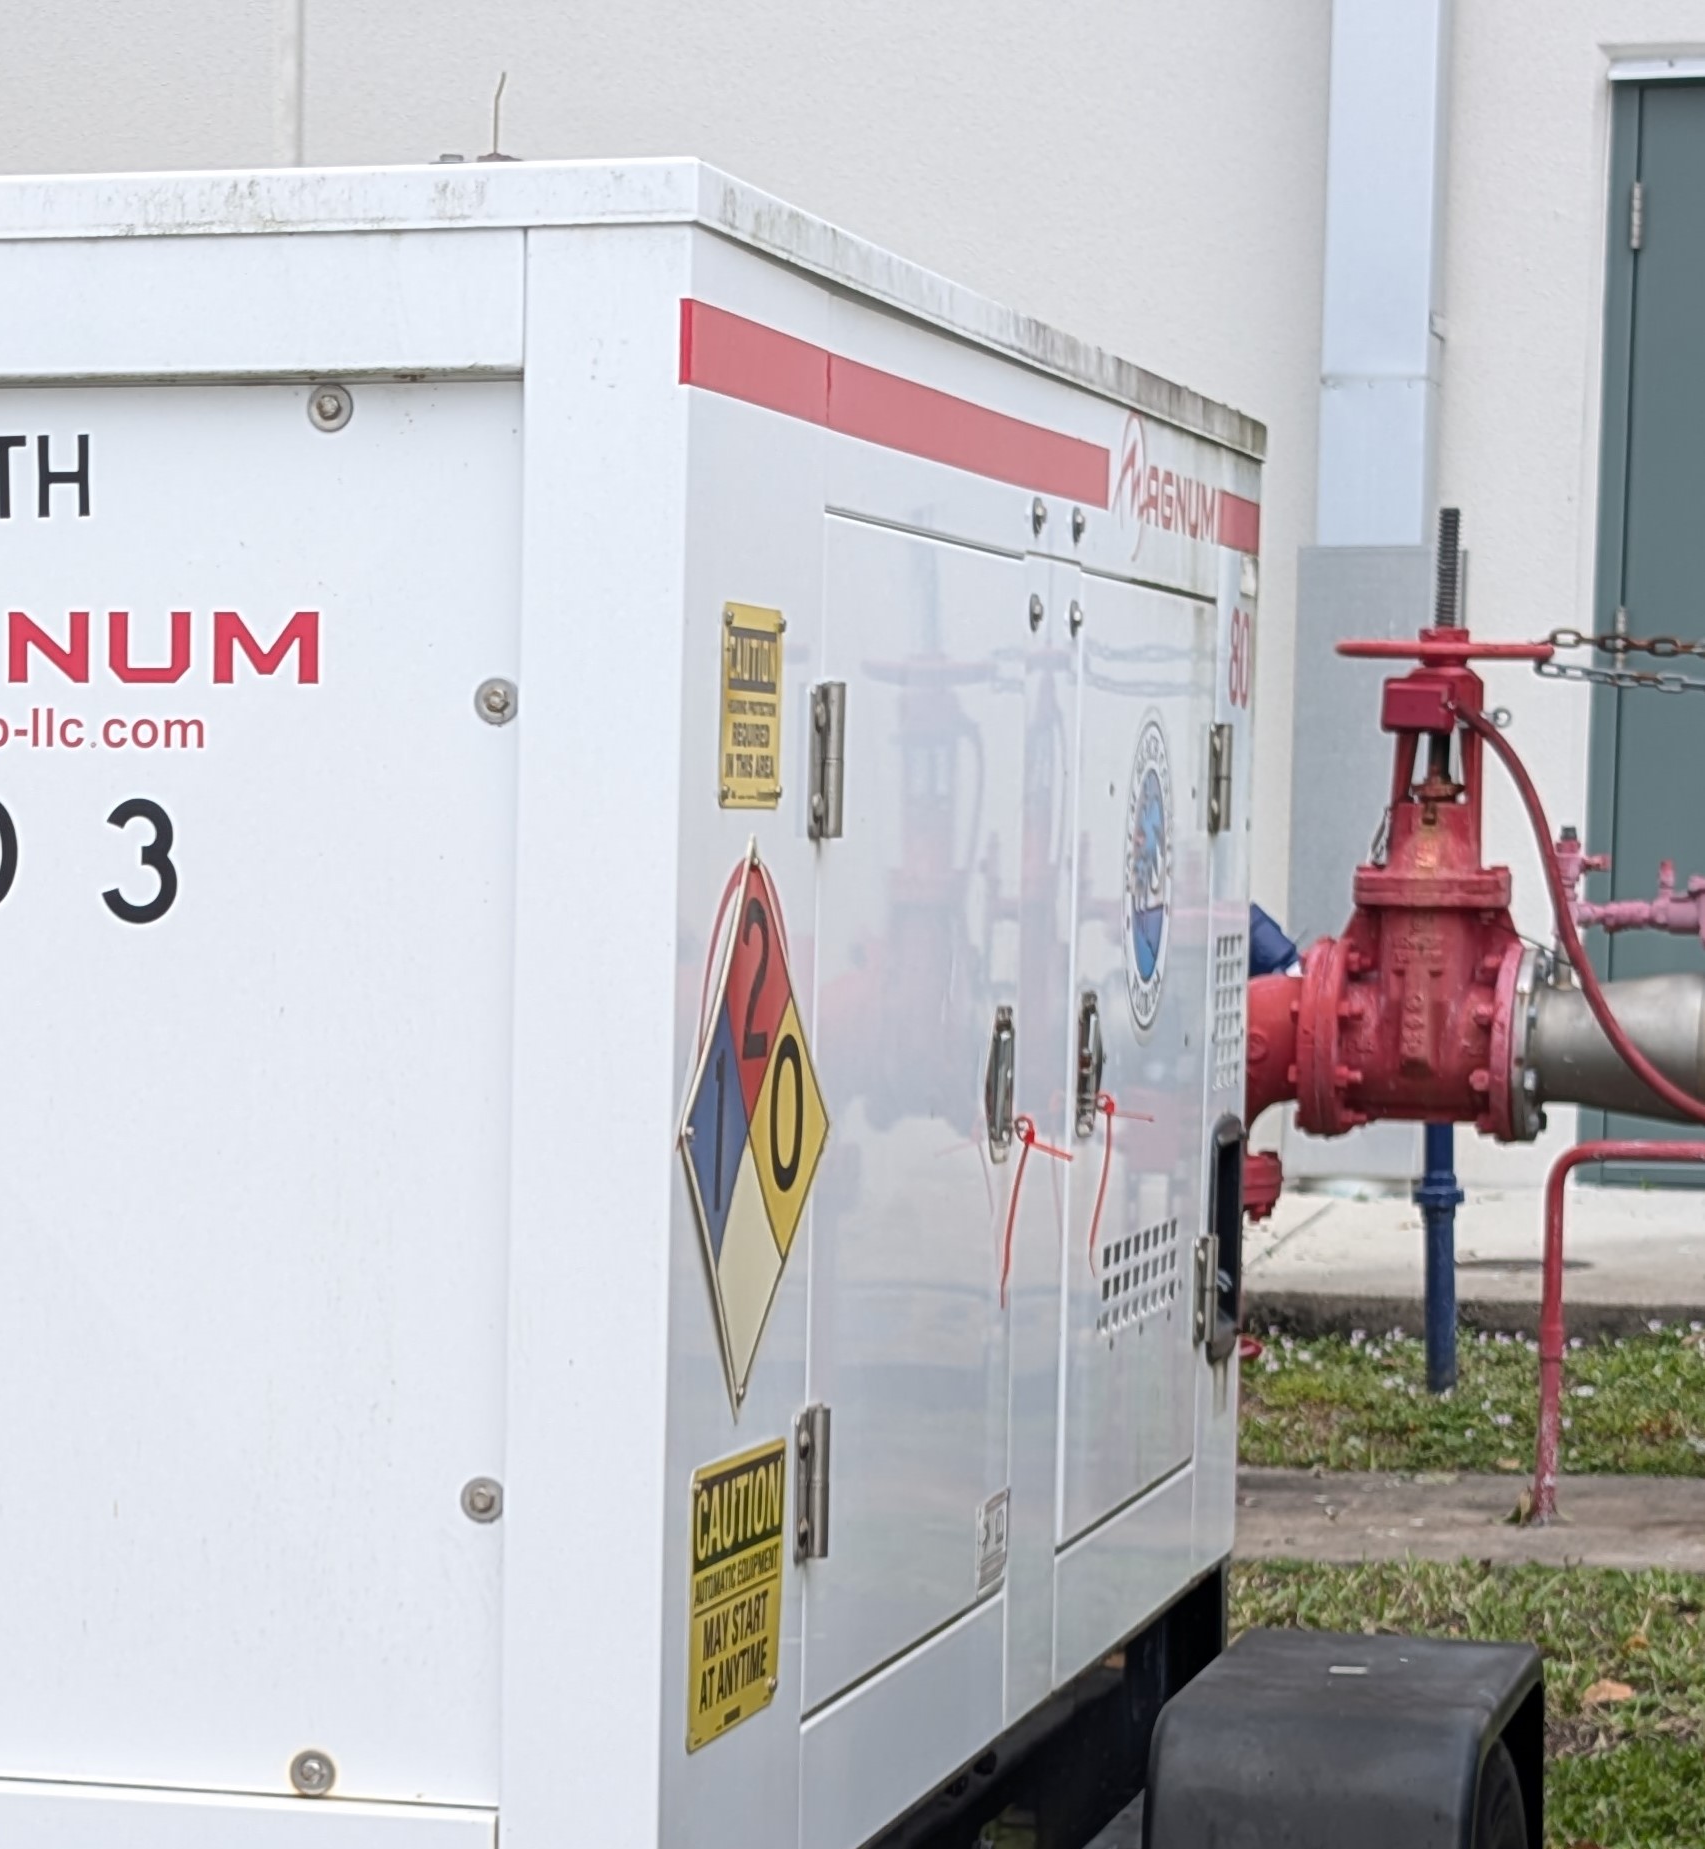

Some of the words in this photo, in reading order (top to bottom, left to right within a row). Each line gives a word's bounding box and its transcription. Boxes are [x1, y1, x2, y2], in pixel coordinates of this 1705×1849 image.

[1112, 408, 1216, 562] MAGNUM
[1228, 606, 1250, 709] 80
[102, 798, 179, 924] 3
[742, 897, 770, 1060] 2
[714, 1049, 727, 1213] 1
[770, 1034, 804, 1193] 0
[697, 1461, 781, 1561] CAUTION
[695, 1560, 735, 1605] AUTOMATIC
[737, 1544, 779, 1589] EQUIPMENT
[703, 1606, 728, 1662] MAY
[732, 1589, 769, 1648] START
[698, 1664, 715, 1714] AT
[716, 1636, 768, 1700] ANYTIME
